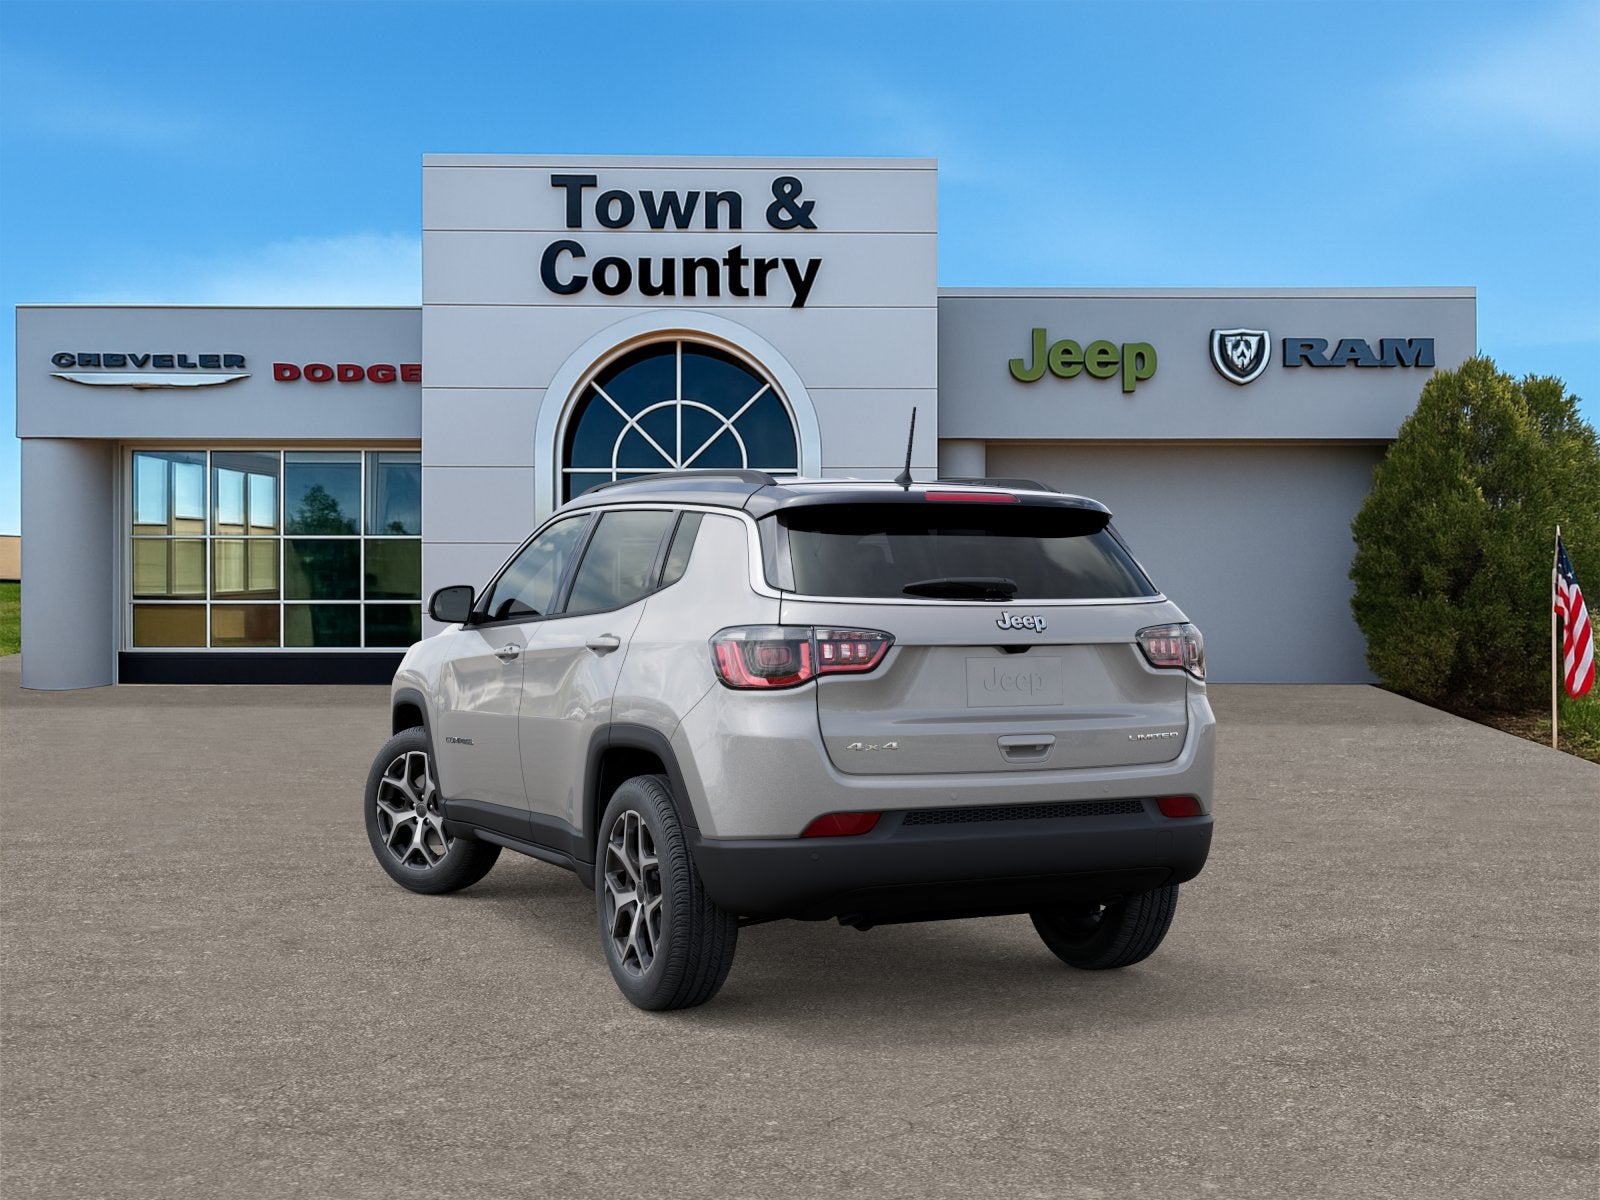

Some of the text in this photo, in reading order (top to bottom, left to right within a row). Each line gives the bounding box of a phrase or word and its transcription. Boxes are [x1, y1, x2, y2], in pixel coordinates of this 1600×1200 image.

[551, 174, 818, 230] Town &
[540, 239, 822, 308] Country
[1009, 328, 1157, 393] Jeep
[1282, 337, 1435, 368] RAM
[273, 362, 422, 382] DODGE
[996, 612, 1047, 633] Jeep
[983, 666, 1043, 695] Jeep
